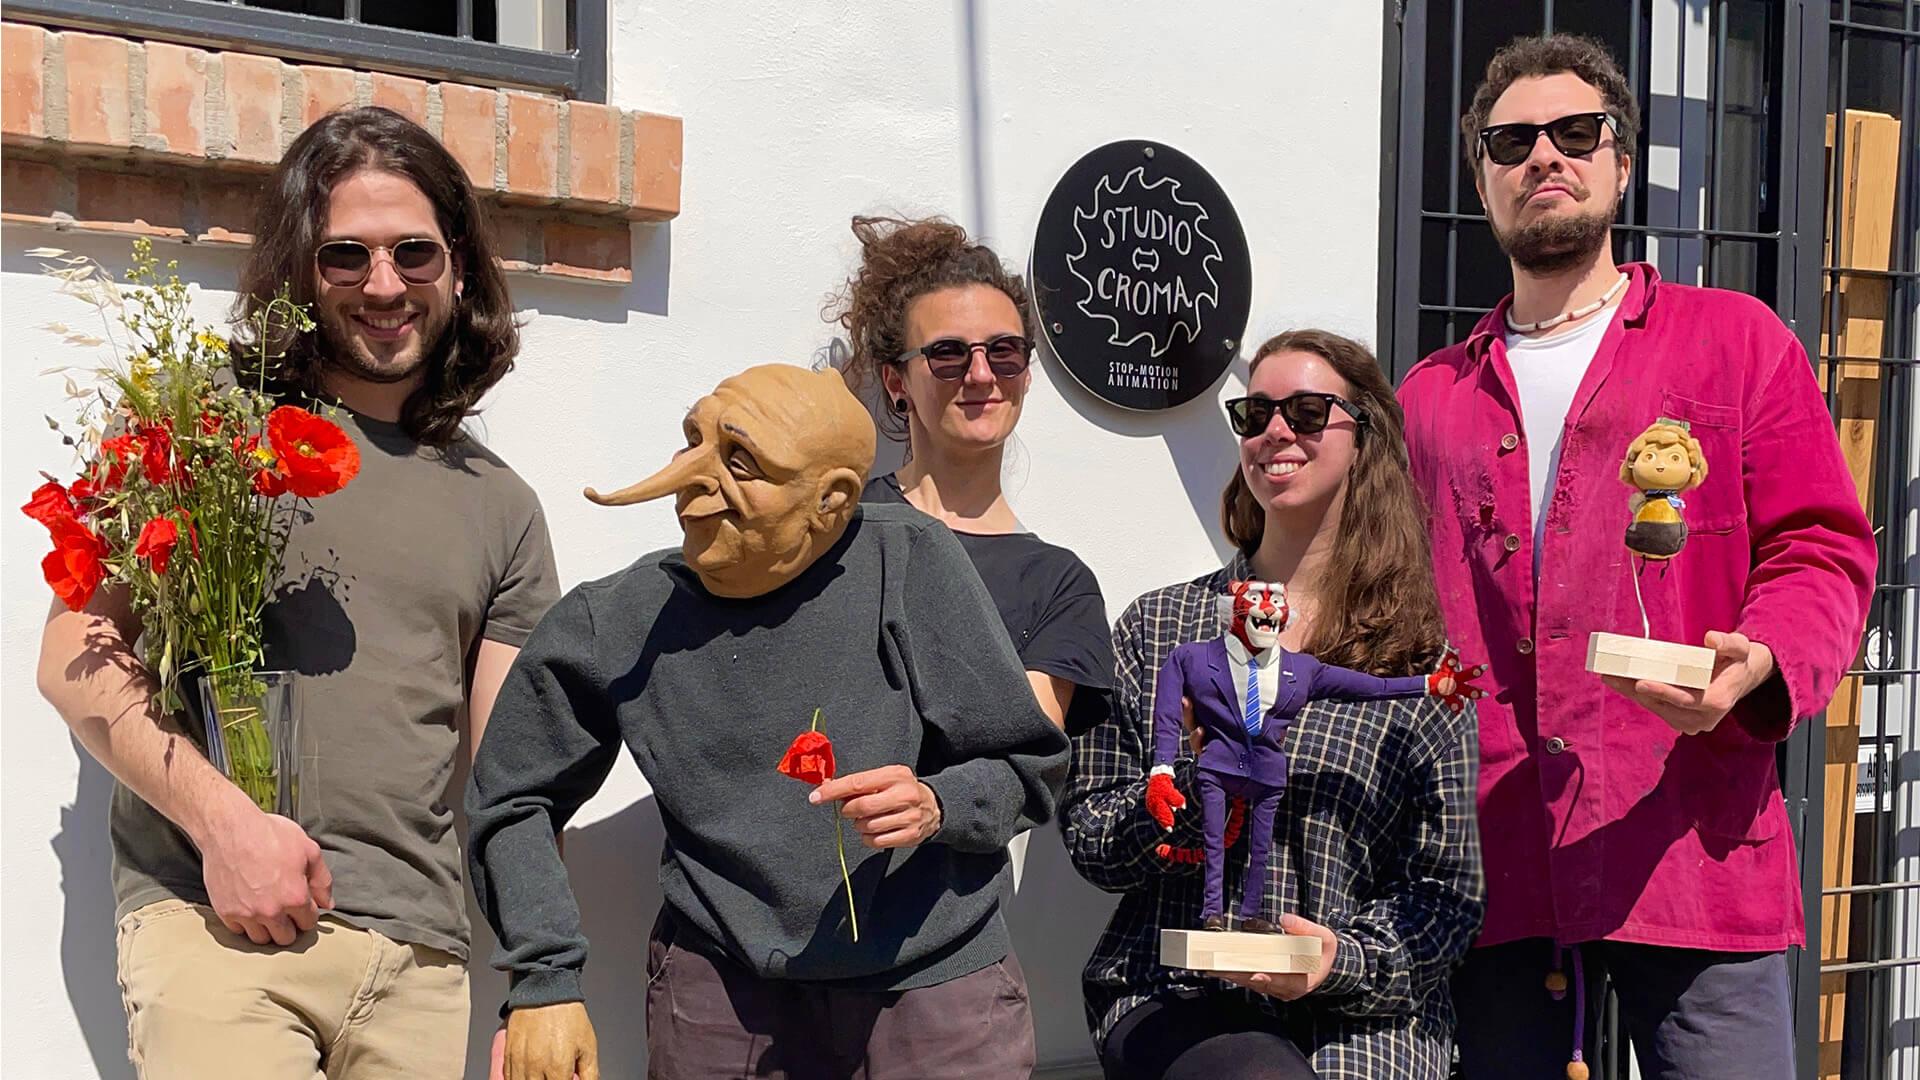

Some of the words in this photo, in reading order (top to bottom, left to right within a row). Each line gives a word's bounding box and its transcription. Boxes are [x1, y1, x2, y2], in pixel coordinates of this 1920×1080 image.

[1101, 206, 1191, 255] STUDIO
[1098, 268, 1192, 315] CROMA
[1108, 374, 1178, 390] ANIMATION
[1109, 362, 1178, 377] STOP-MOTION
